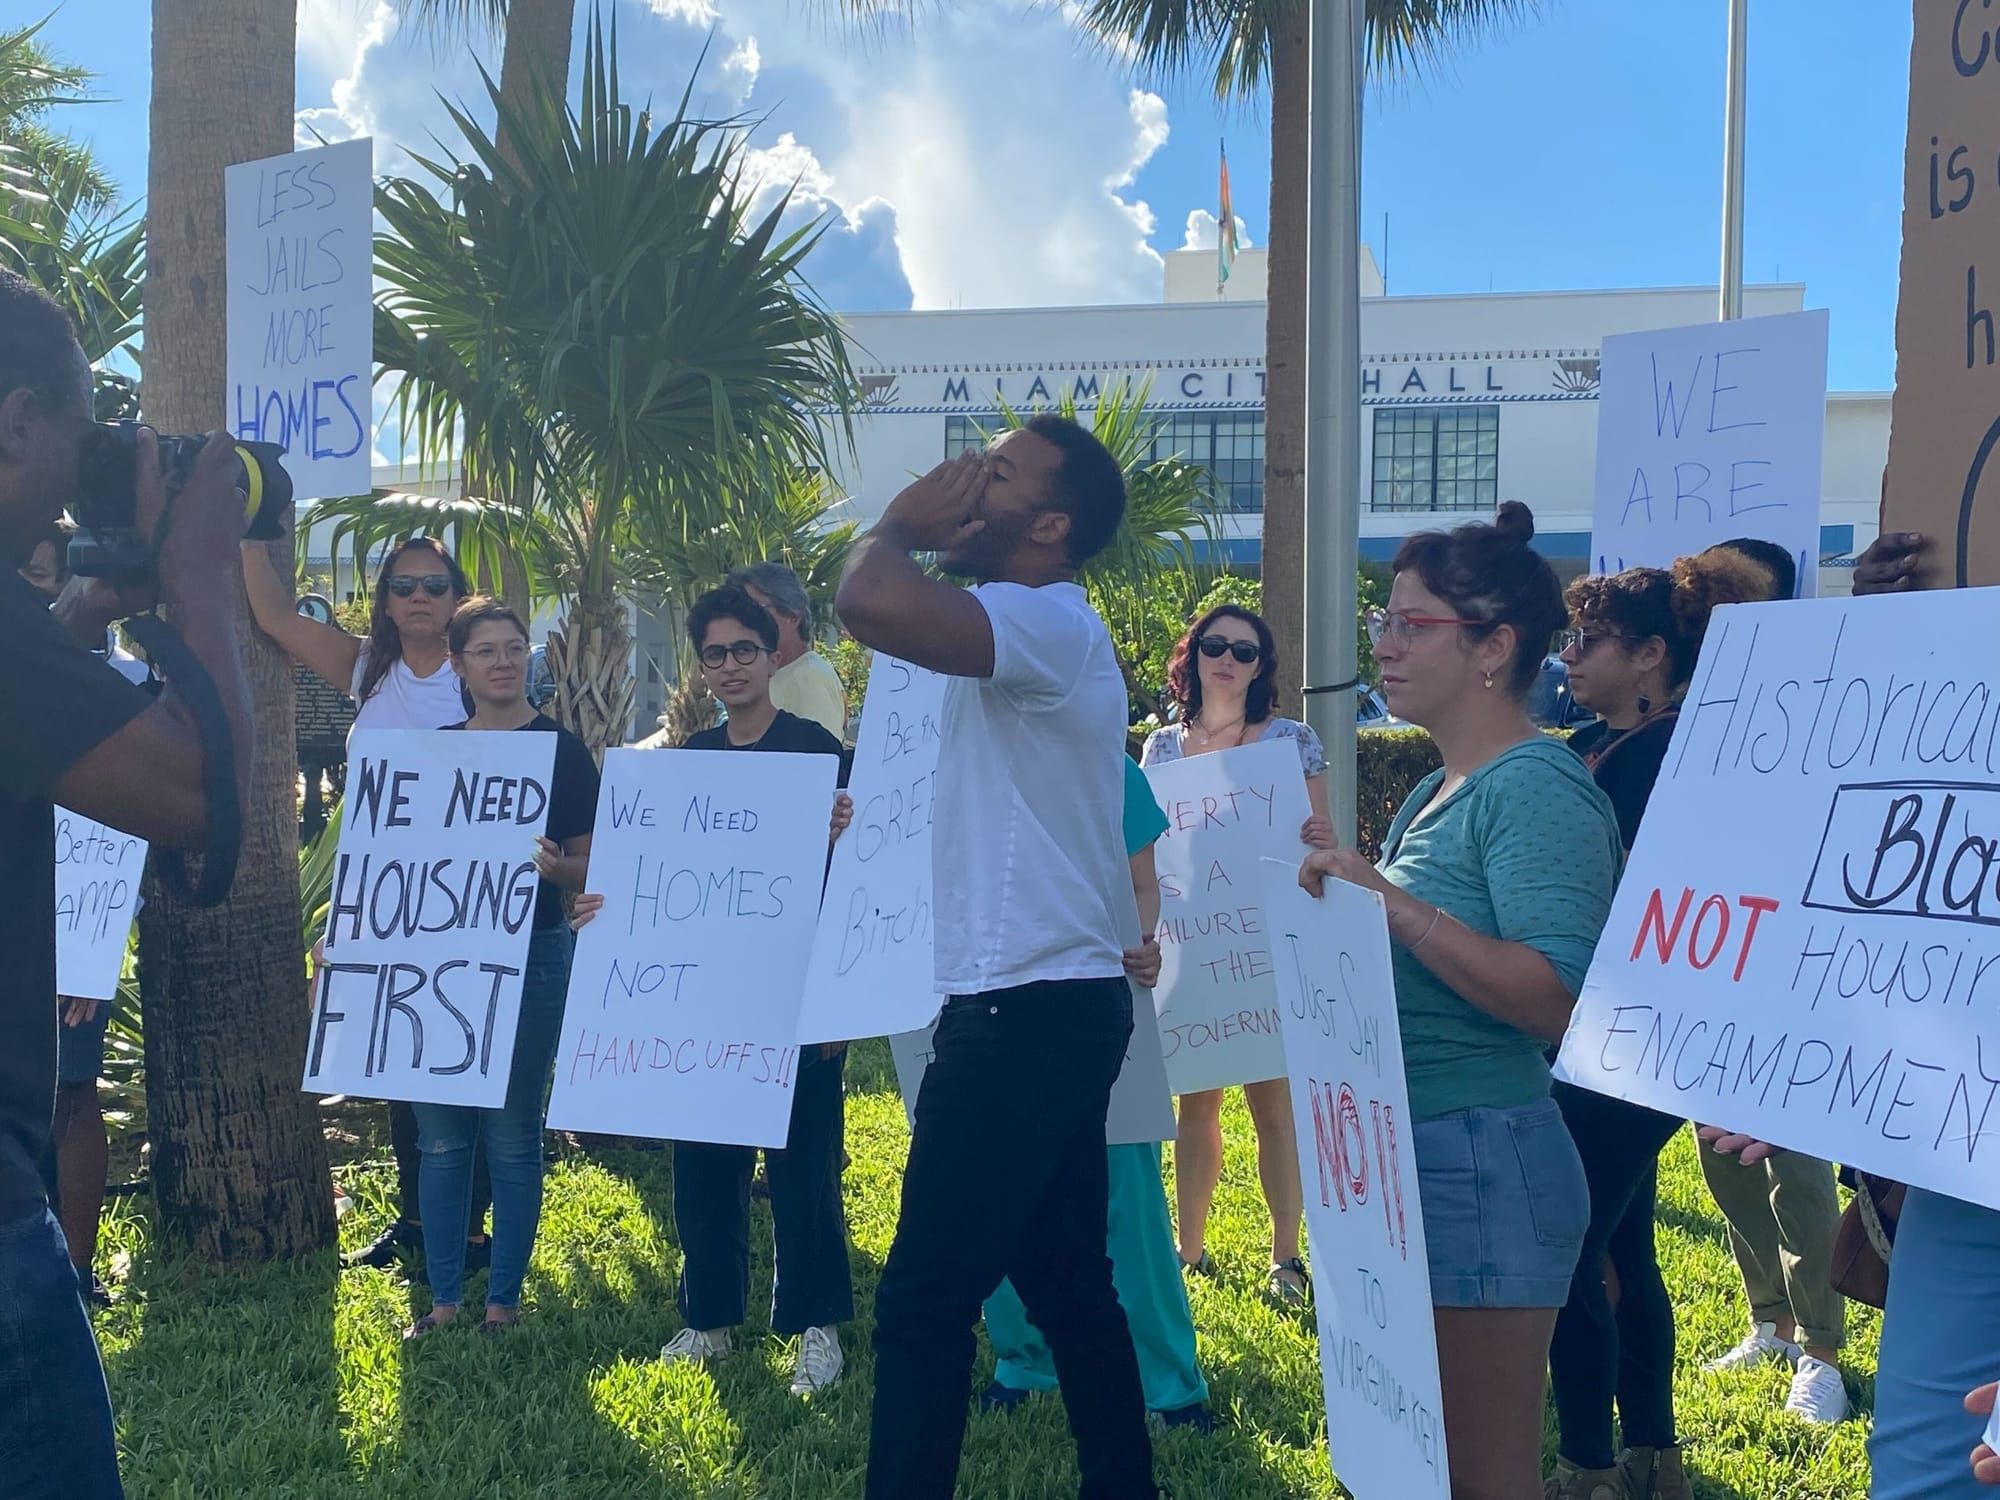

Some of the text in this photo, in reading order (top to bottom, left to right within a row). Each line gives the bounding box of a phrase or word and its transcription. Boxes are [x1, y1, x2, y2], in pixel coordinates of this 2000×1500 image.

[257, 161, 336, 229] LESS
[246, 228, 344, 296] JAILS
[263, 304, 337, 369] MORE
[942, 374, 1132, 402] MIAMI
[1362, 365, 1504, 395] HALL
[1651, 348, 1768, 439] WE
[234, 374, 364, 462] HOMES
[1620, 460, 1789, 527] ARE
[350, 756, 548, 838] WE NEED
[610, 784, 759, 834] WE NEED
[53, 818, 137, 867] Better
[1206, 859, 1234, 893] A
[1842, 793, 2000, 918] Bla
[326, 853, 538, 948] HOUSING
[628, 853, 793, 936] HOMES
[1199, 949, 1276, 985] THE
[1629, 885, 1781, 983] NOT
[602, 958, 700, 1011] NOT
[309, 959, 520, 1078] FIRST
[569, 1028, 796, 1090] HANDCUFFS!!
[1356, 1266, 1388, 1331] TO
